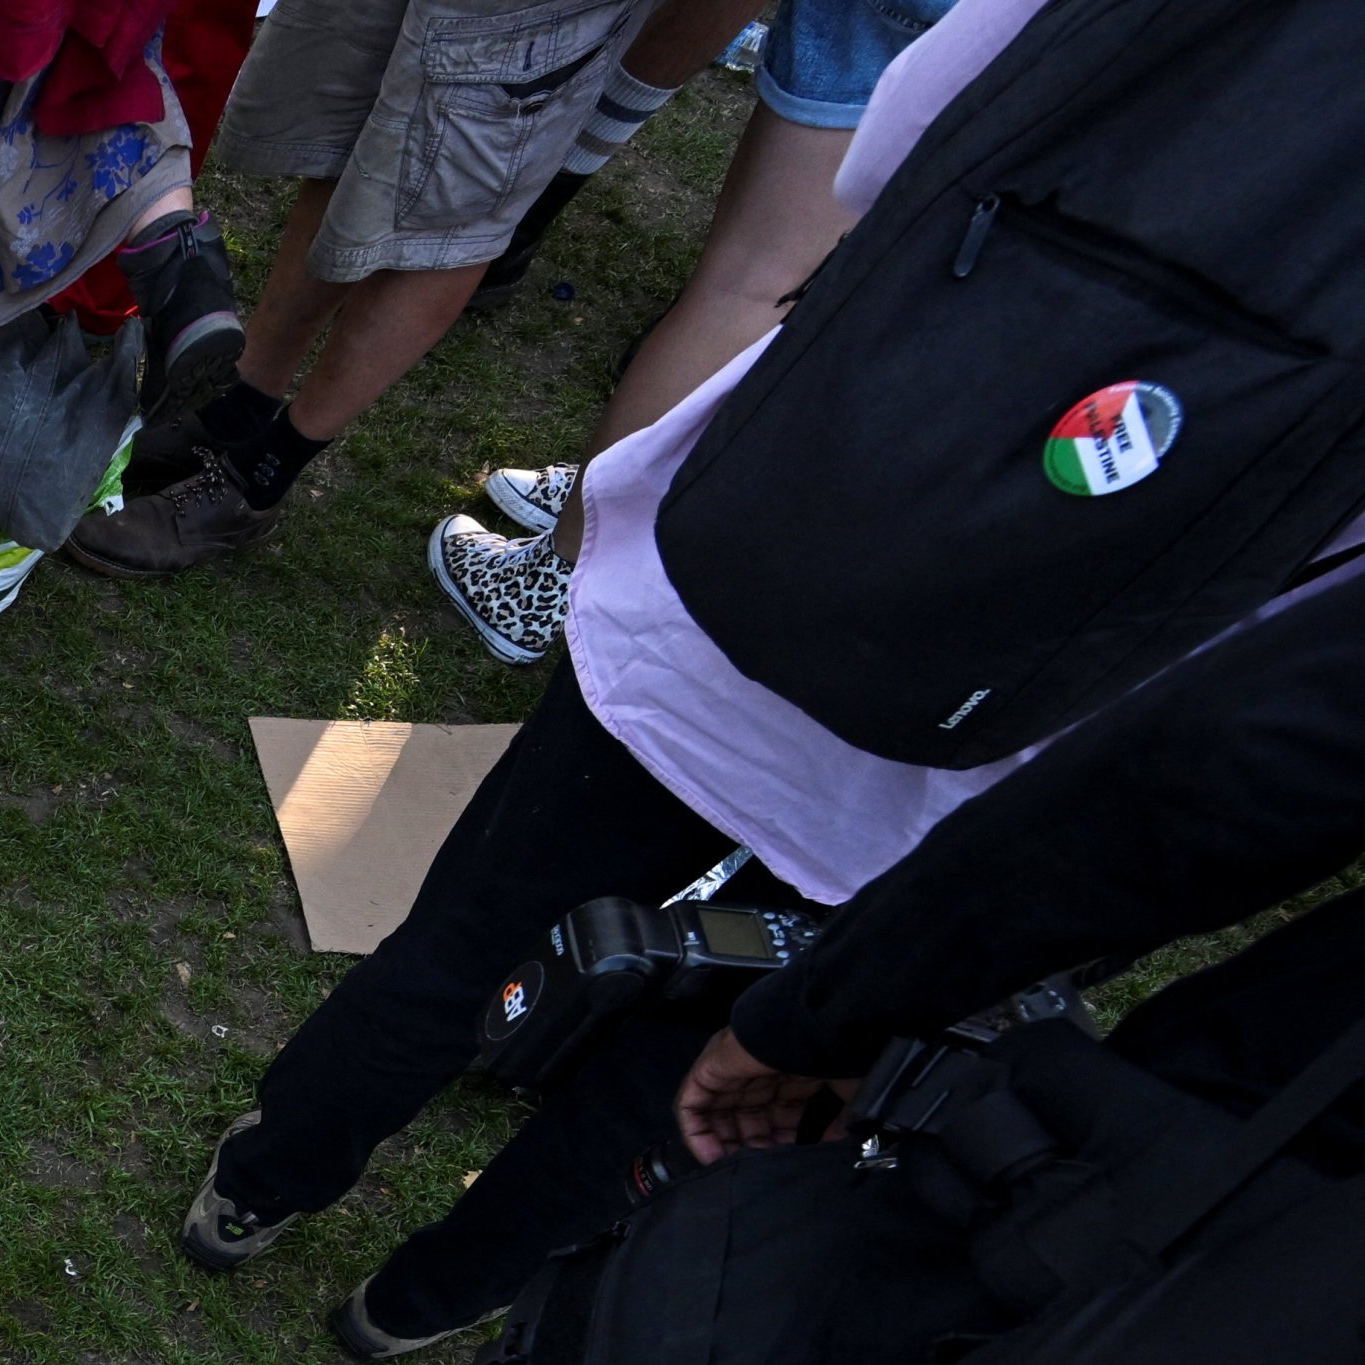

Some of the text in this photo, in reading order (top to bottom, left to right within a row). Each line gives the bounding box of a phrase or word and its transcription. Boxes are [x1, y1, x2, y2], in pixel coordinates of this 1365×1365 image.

[1085, 400, 1121, 484] PALESTINE
[1112, 414, 1133, 453] FREE
[937, 688, 992, 729] Lenovo
